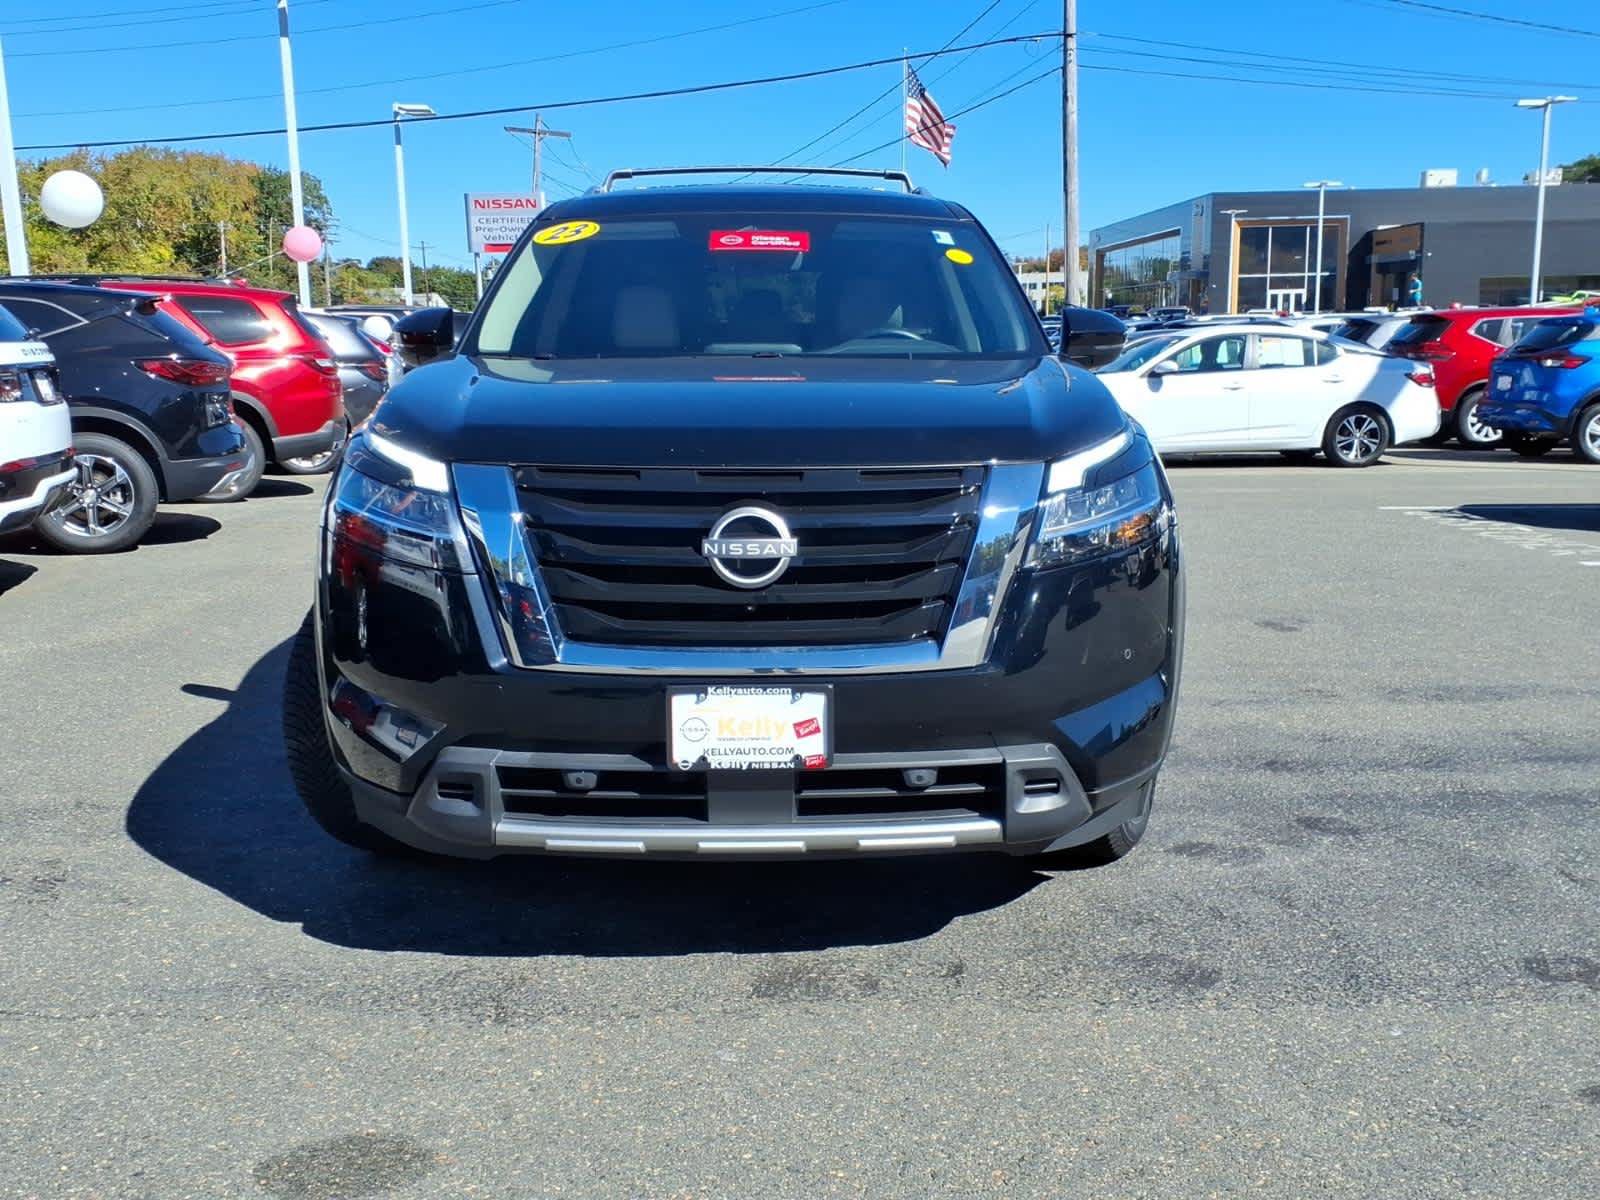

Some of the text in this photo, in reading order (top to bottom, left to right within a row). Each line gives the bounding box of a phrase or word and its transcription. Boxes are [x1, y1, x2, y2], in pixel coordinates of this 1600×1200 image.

[474, 199, 537, 208] NISSAN
[544, 223, 589, 241] 23
[704, 543, 795, 555] NISSAN
[707, 686, 792, 697] Kellyauto.com
[717, 716, 787, 740] Kelly
[703, 747, 795, 757] KELLYAUTO.COM
[751, 761, 795, 769] NISSAN
